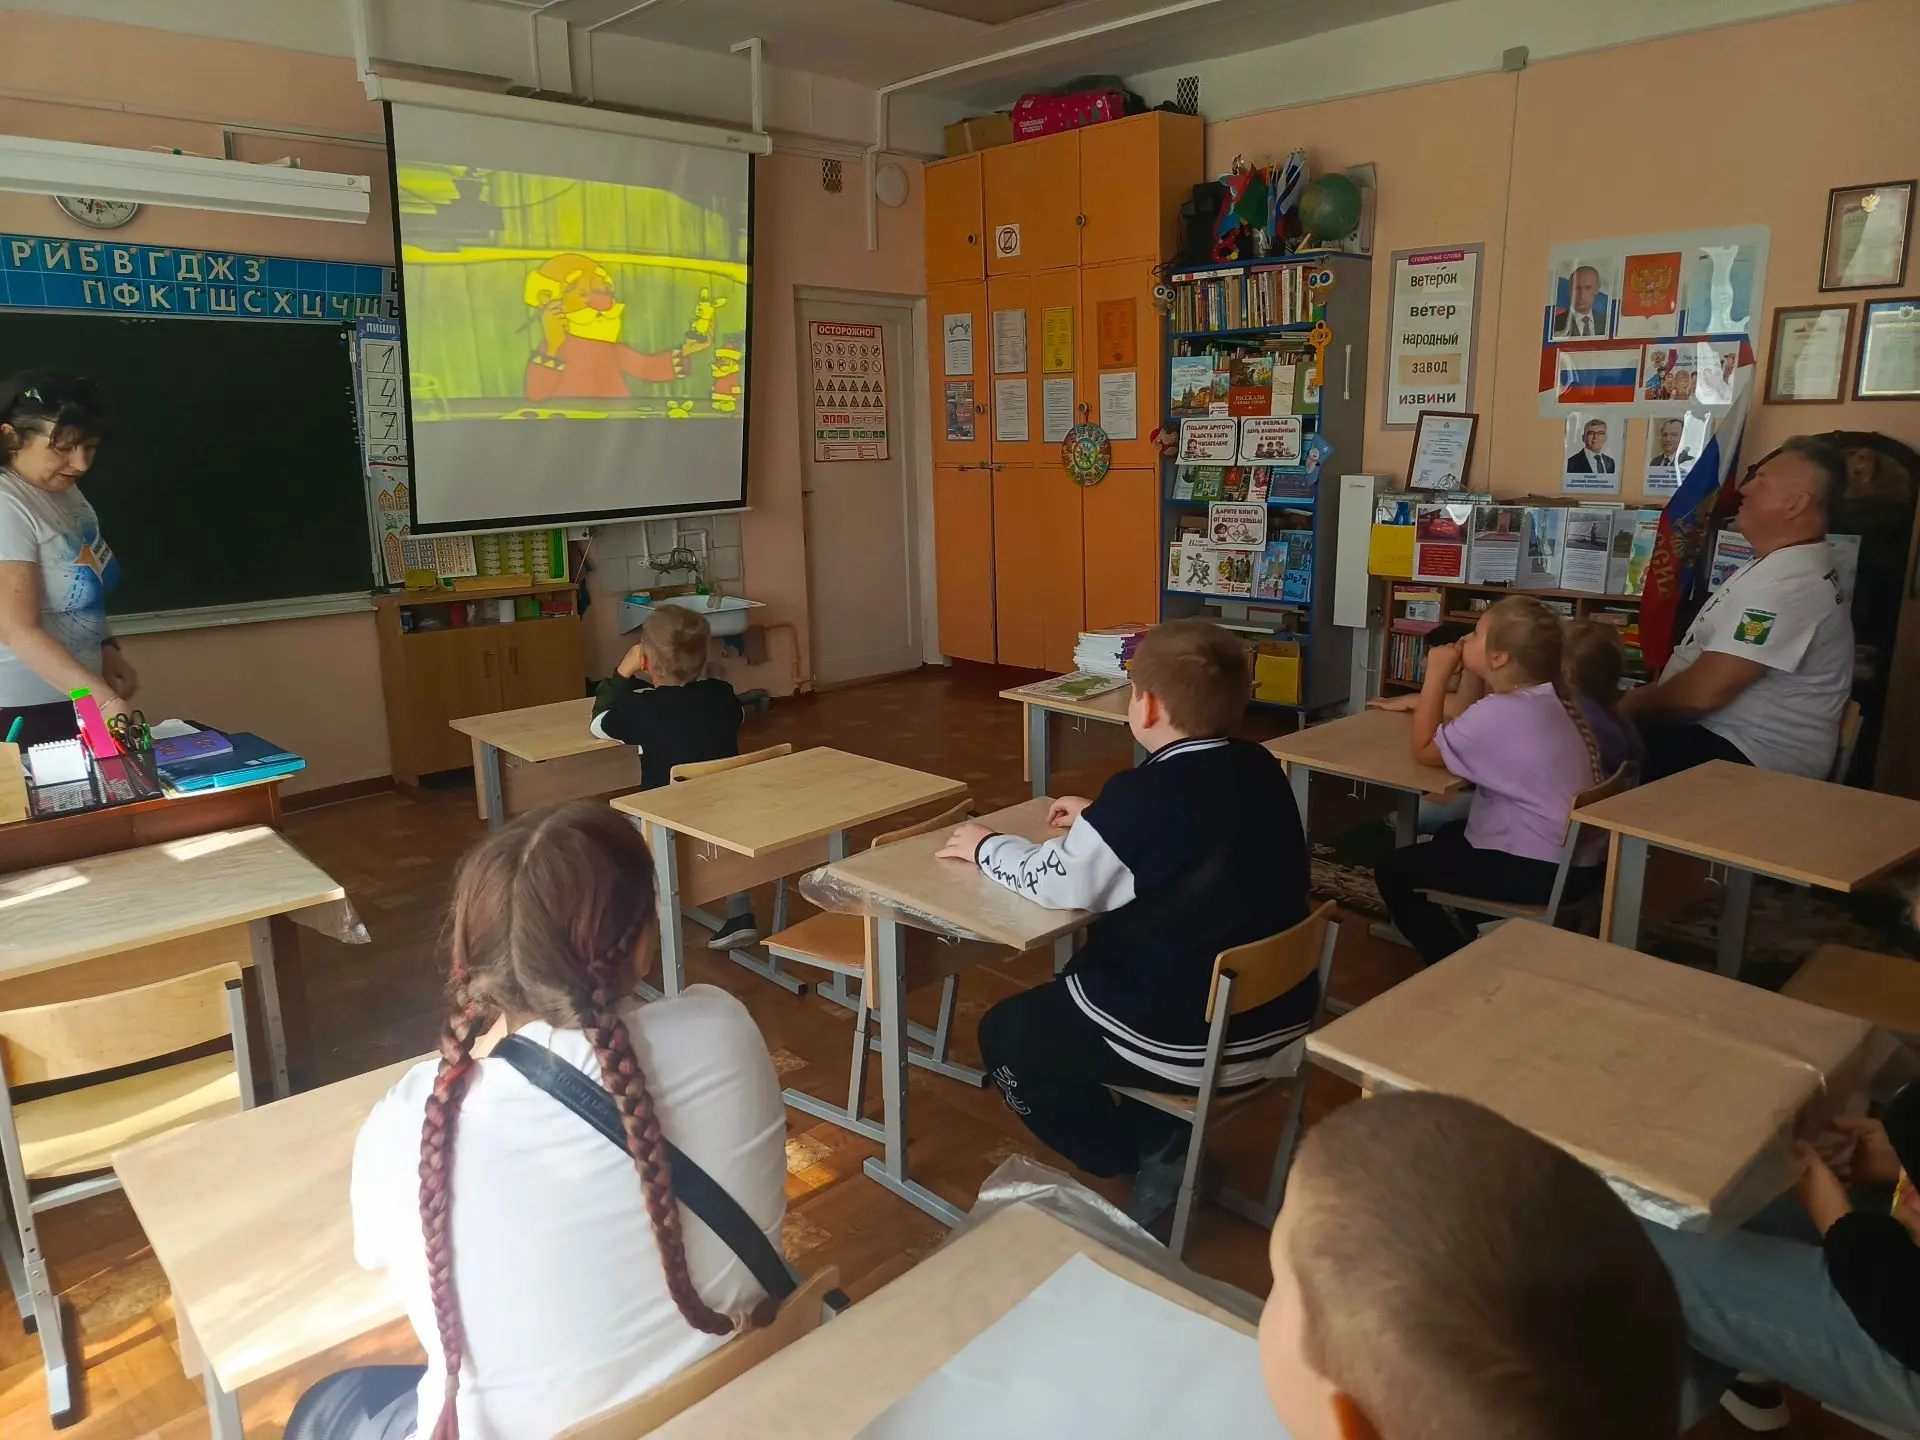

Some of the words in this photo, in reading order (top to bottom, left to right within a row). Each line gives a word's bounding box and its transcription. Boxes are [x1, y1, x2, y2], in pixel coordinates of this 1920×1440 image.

[11, 241, 31, 267] Р
[44, 243, 72, 270] Й
[79, 247, 99, 272] Б
[113, 249, 133, 274] В
[149, 251, 166, 276] Г
[177, 255, 202, 282] Д
[207, 256, 235, 281] Ж
[1443, 253, 1462, 261] СЛОВА
[83, 279, 106, 305] П
[113, 282, 140, 307] Ф
[149, 284, 172, 309] К
[183, 286, 201, 310] Т
[210, 288, 236, 312] Ш
[243, 290, 262, 313] С
[273, 291, 293, 315] Х
[303, 294, 322, 318] Ц
[332, 296, 348, 316] Ч
[366, 323, 396, 335] ПИШИ
[818, 325, 873, 337] ОСТОРОЖНО!
[1402, 331, 1459, 348] народный
[1411, 360, 1448, 374] завод
[1399, 392, 1456, 405] извини
